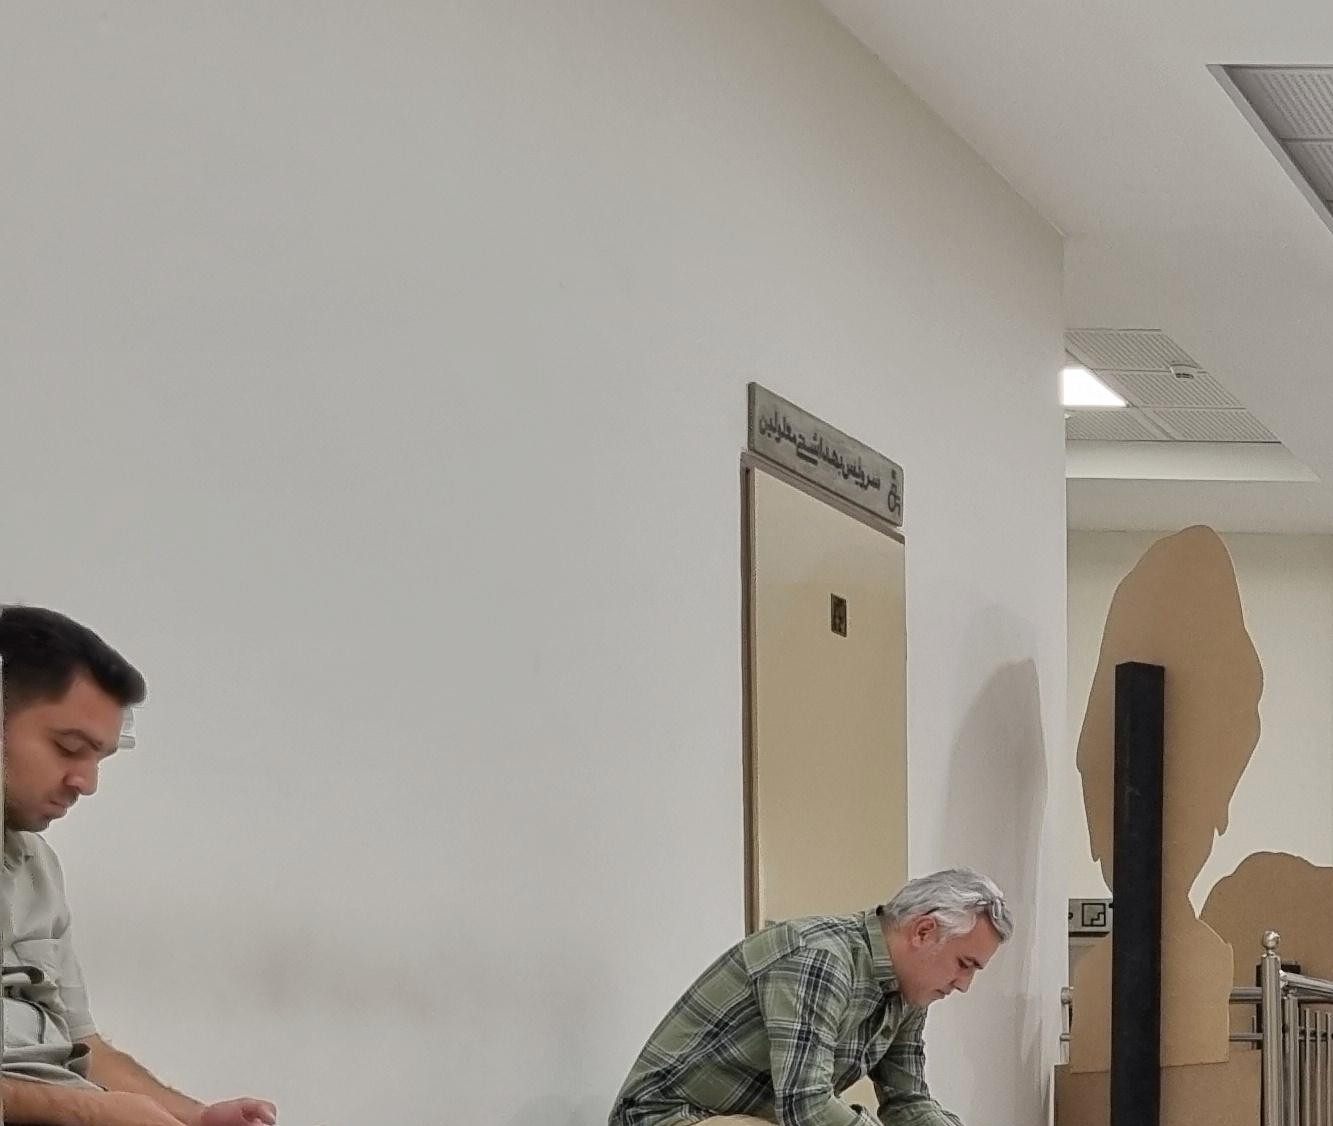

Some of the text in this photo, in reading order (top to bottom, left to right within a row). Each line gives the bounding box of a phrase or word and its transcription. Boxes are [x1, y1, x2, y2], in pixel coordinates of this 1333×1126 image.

[759, 411, 881, 490] سرویس بهداشتی معلولین
